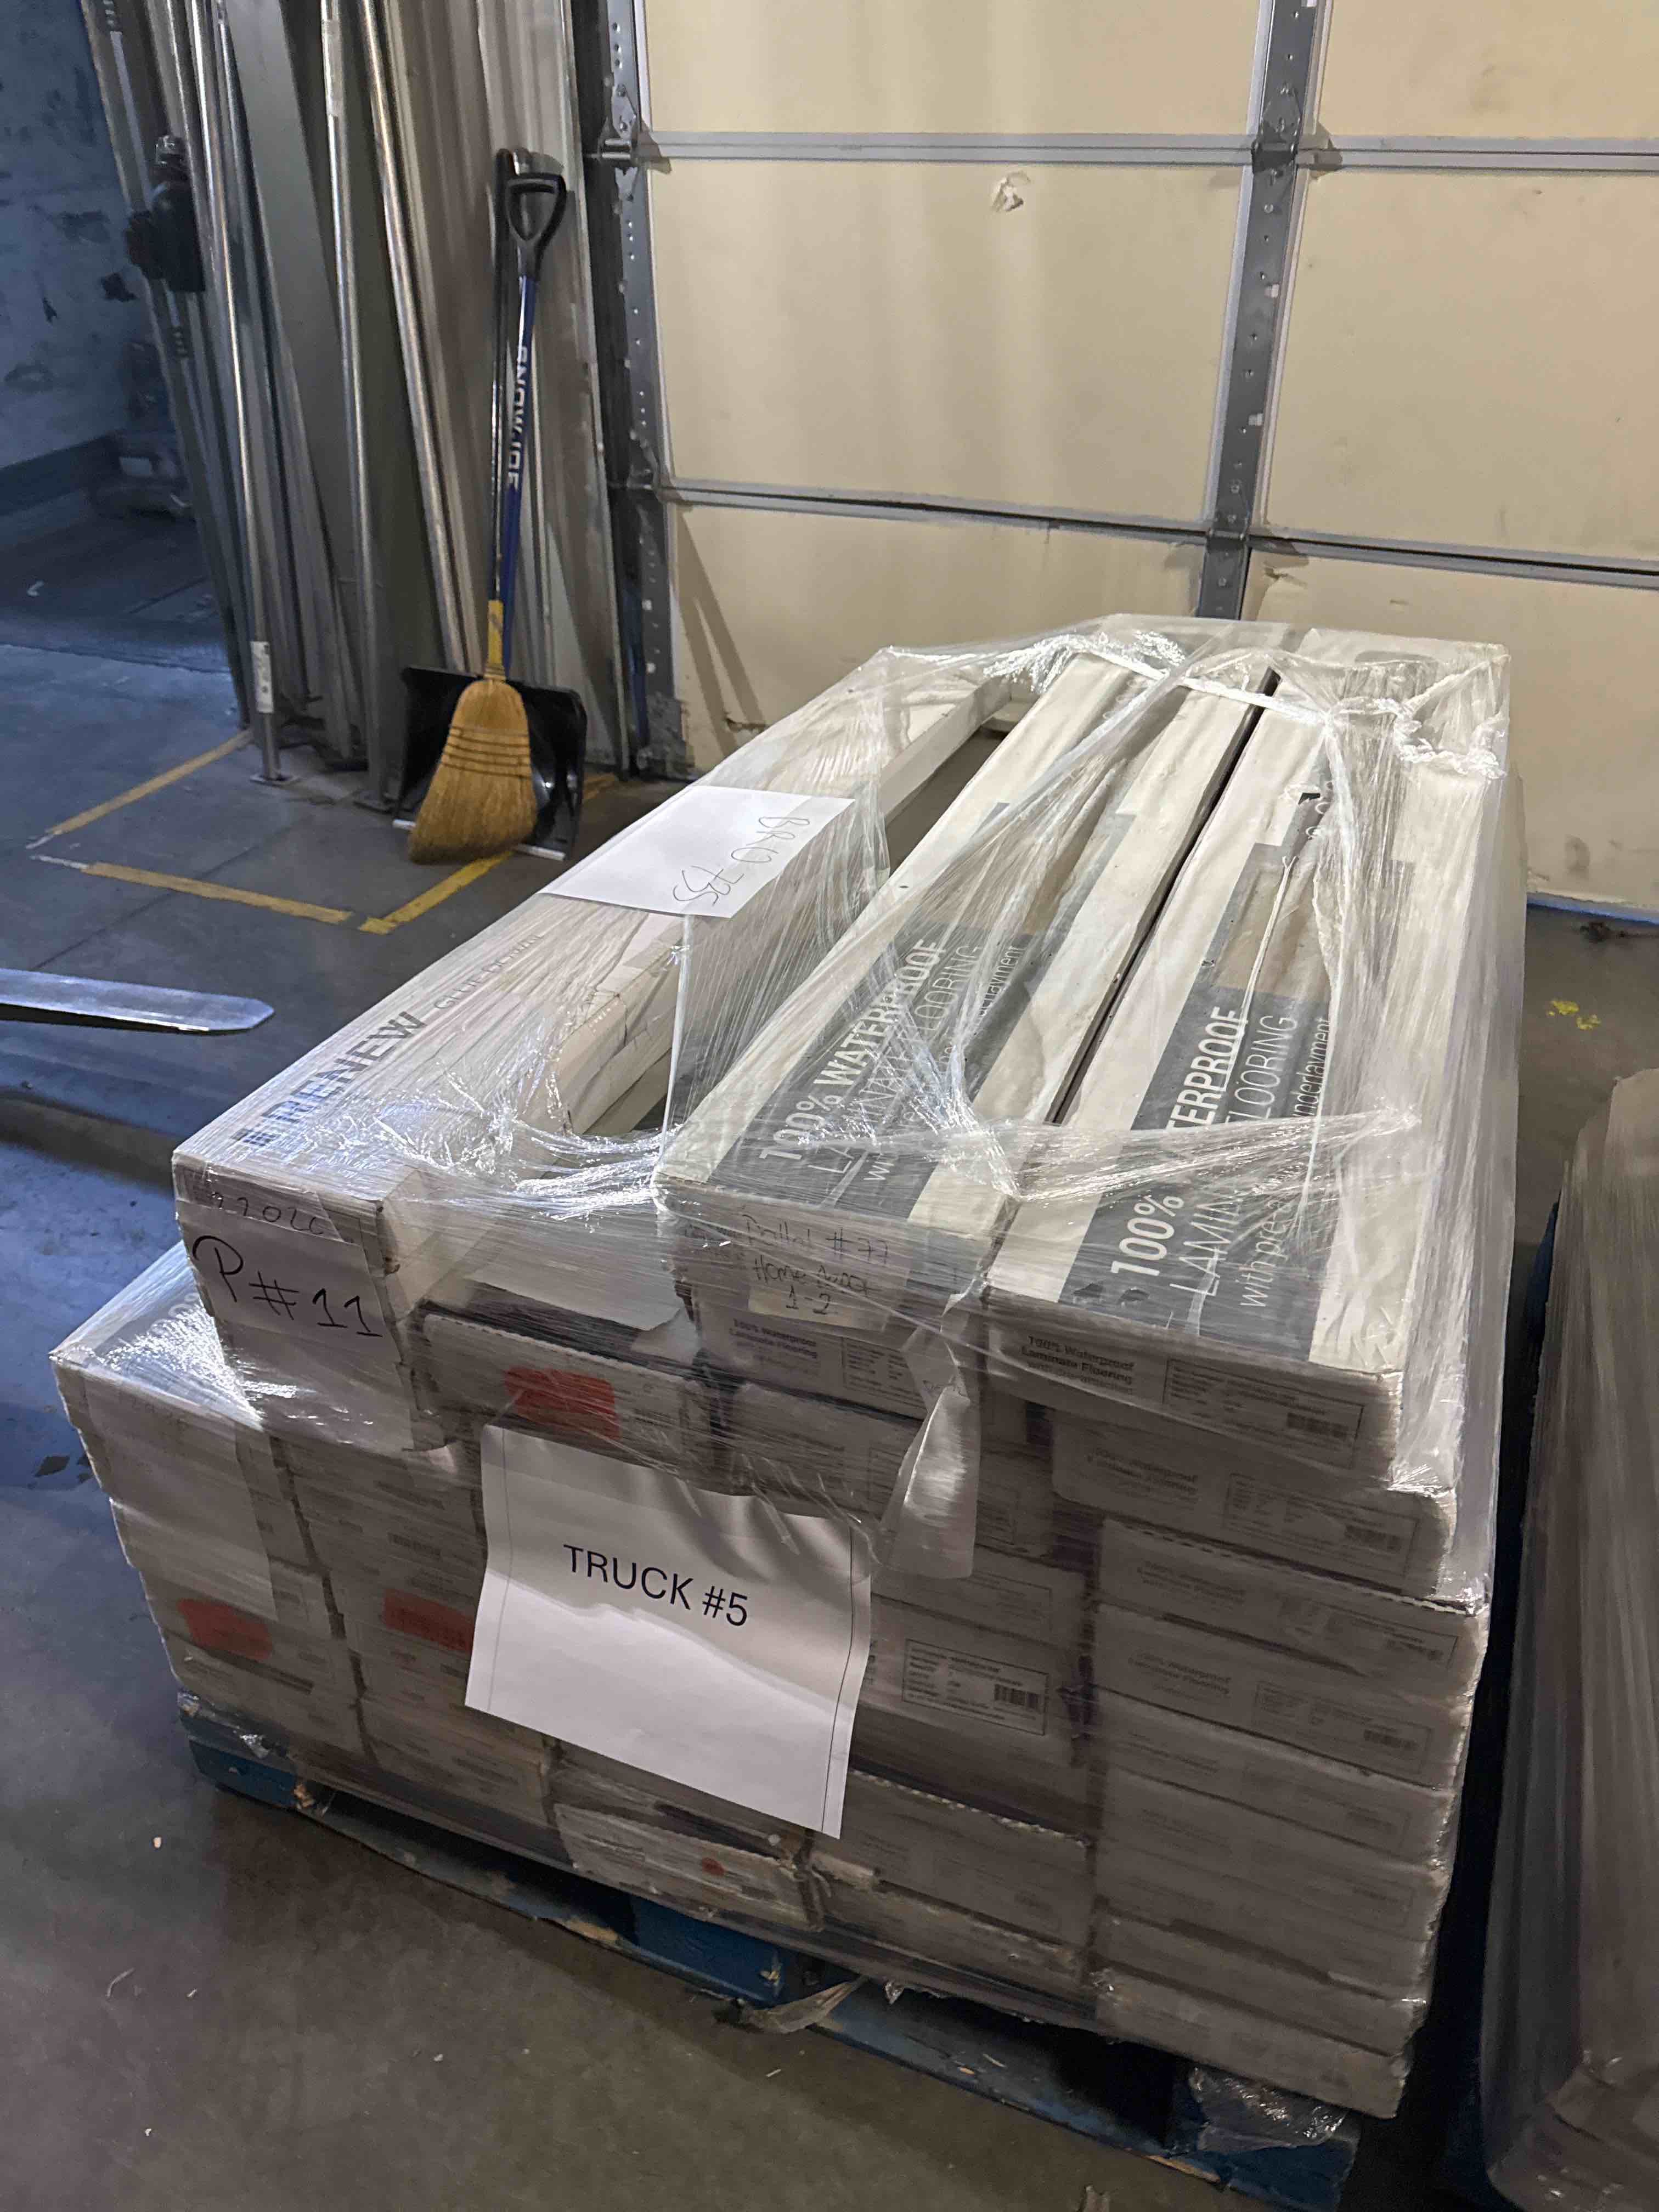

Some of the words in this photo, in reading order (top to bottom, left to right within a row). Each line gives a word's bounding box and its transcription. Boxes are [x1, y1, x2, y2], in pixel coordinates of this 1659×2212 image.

[1224, 1015, 1297, 1125] LOORING
[1110, 1194, 1184, 1277] 100%
[1165, 1006, 1247, 1131] TERPROOF
[752, 1254, 807, 1285] Home
[563, 1544, 693, 1610] TRUCK
[702, 1585, 748, 1626] #5
